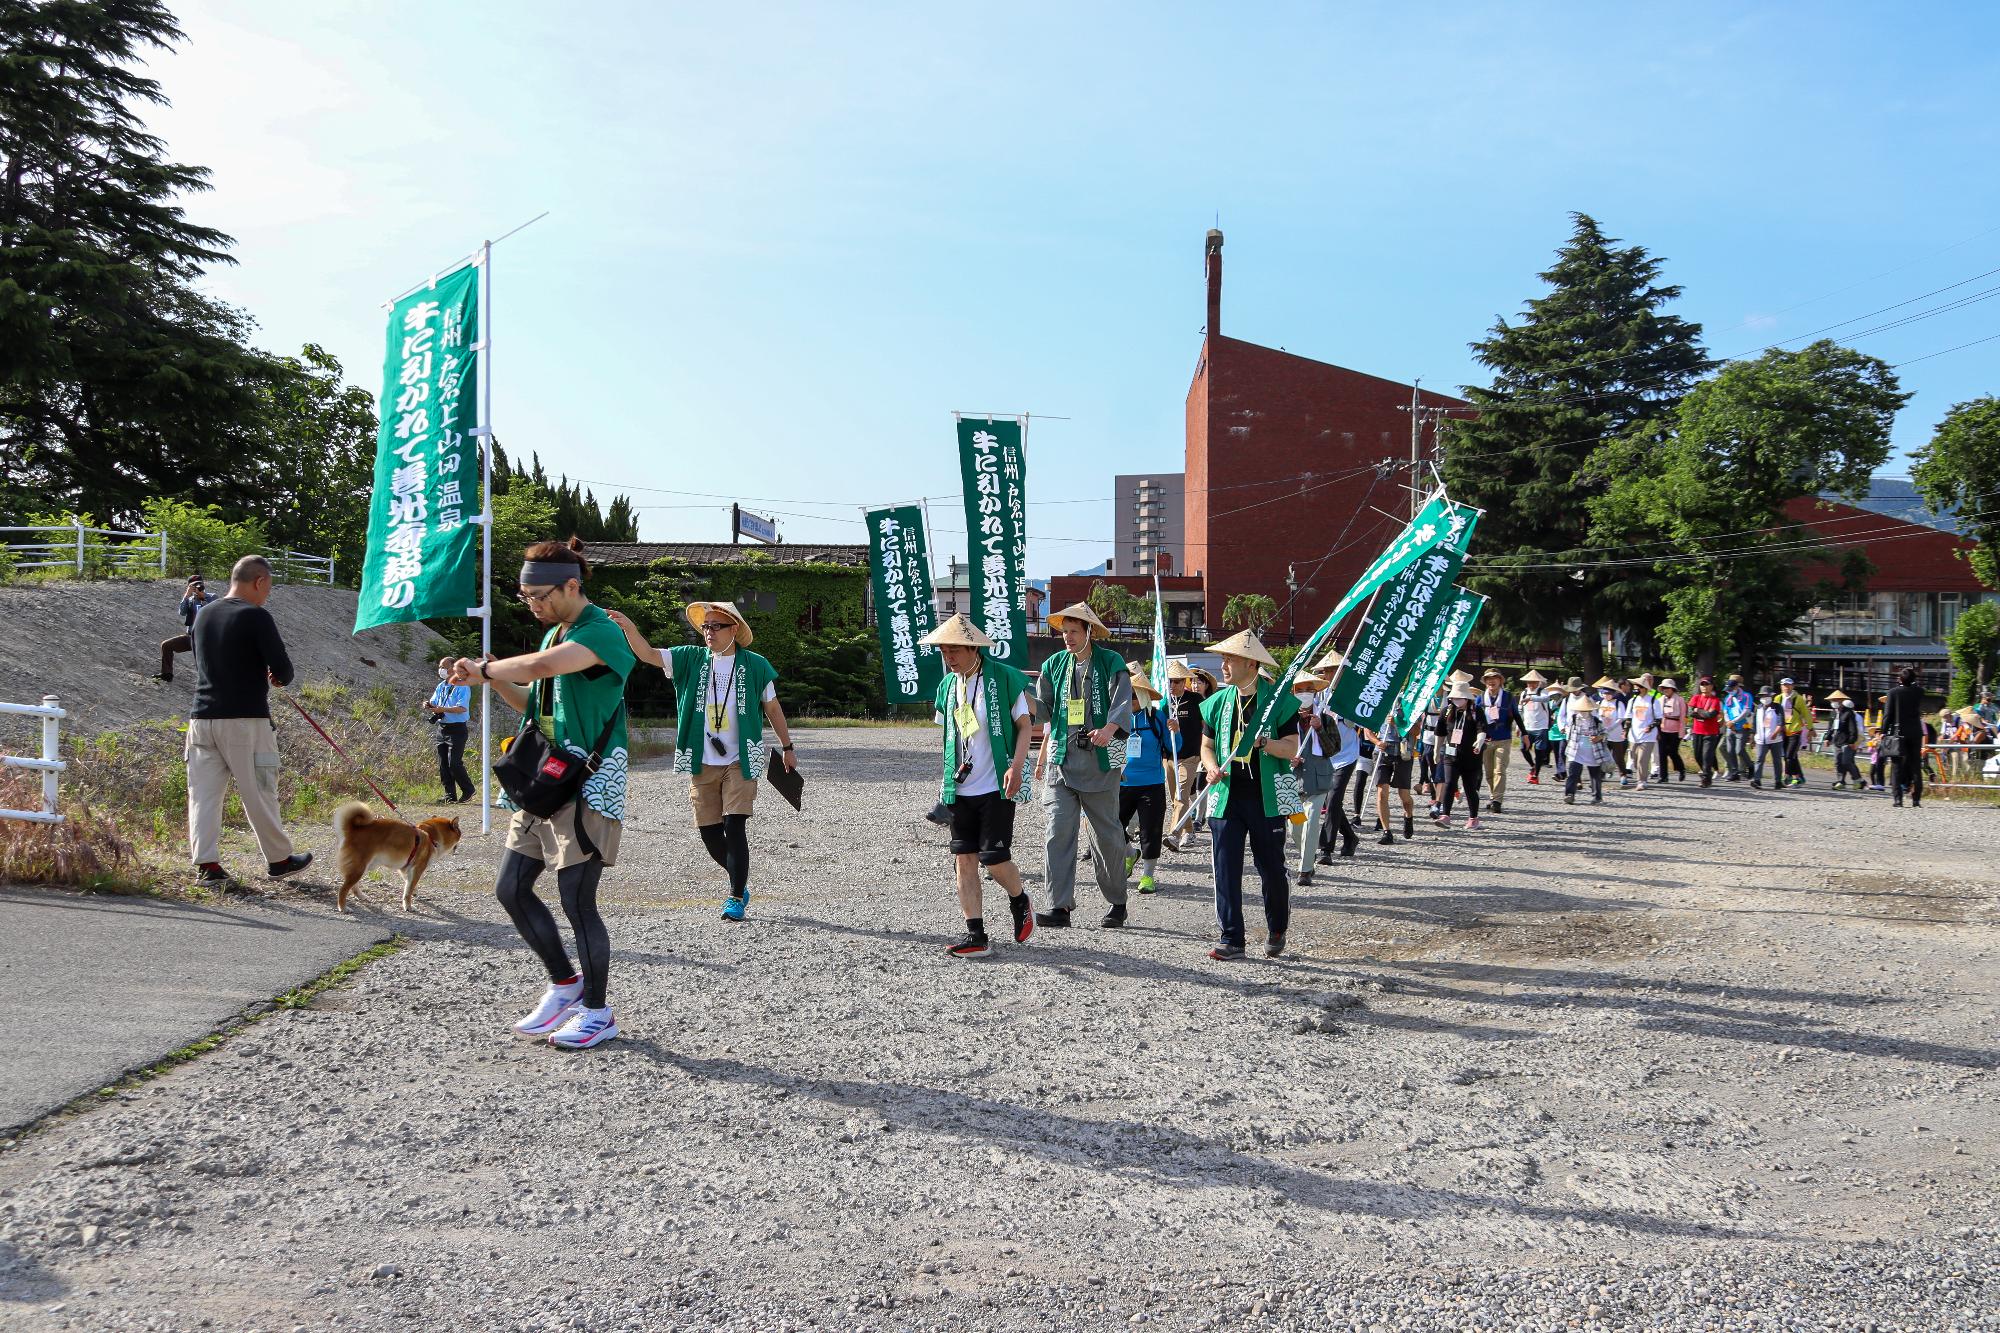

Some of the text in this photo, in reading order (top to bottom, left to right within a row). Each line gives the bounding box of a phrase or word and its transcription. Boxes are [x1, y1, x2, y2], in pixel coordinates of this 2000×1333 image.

[381, 301, 440, 608] 牛に引かれて善光寺詣り
[973, 430, 1012, 659] 牛に引かれて善光寺詣り
[879, 517, 919, 696] 牛に引かれて善光寺詣り
